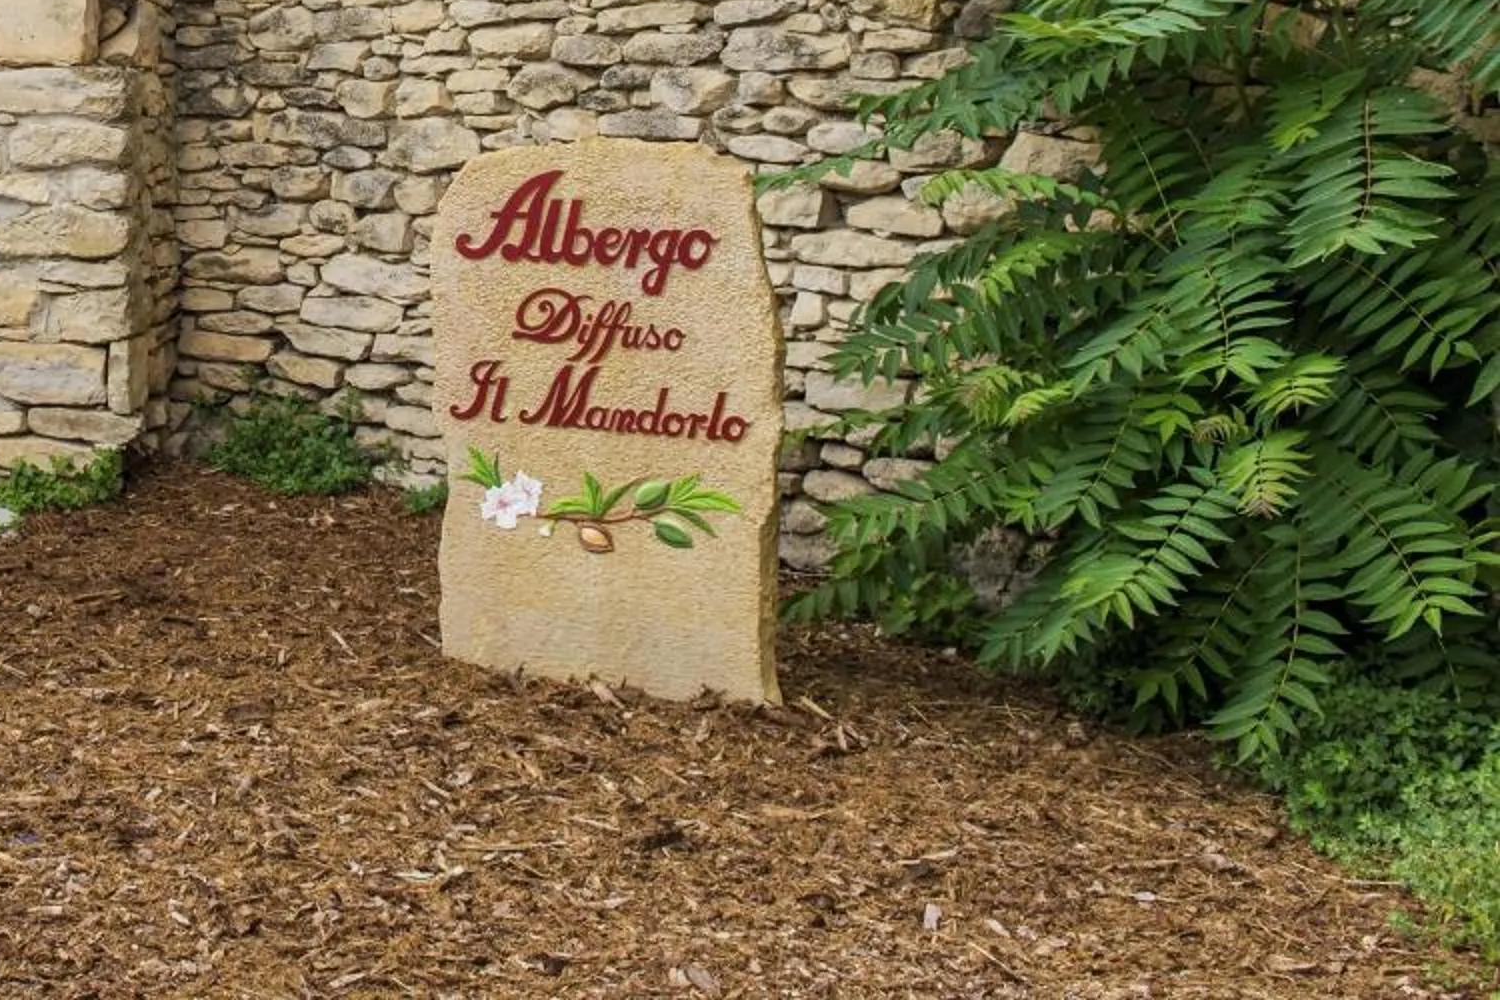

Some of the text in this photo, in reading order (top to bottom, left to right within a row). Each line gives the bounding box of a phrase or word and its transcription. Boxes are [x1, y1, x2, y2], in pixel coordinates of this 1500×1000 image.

[455, 169, 720, 296] Albergo
[512, 287, 686, 362] Diffuso
[450, 359, 753, 442] Il Mandorlo
